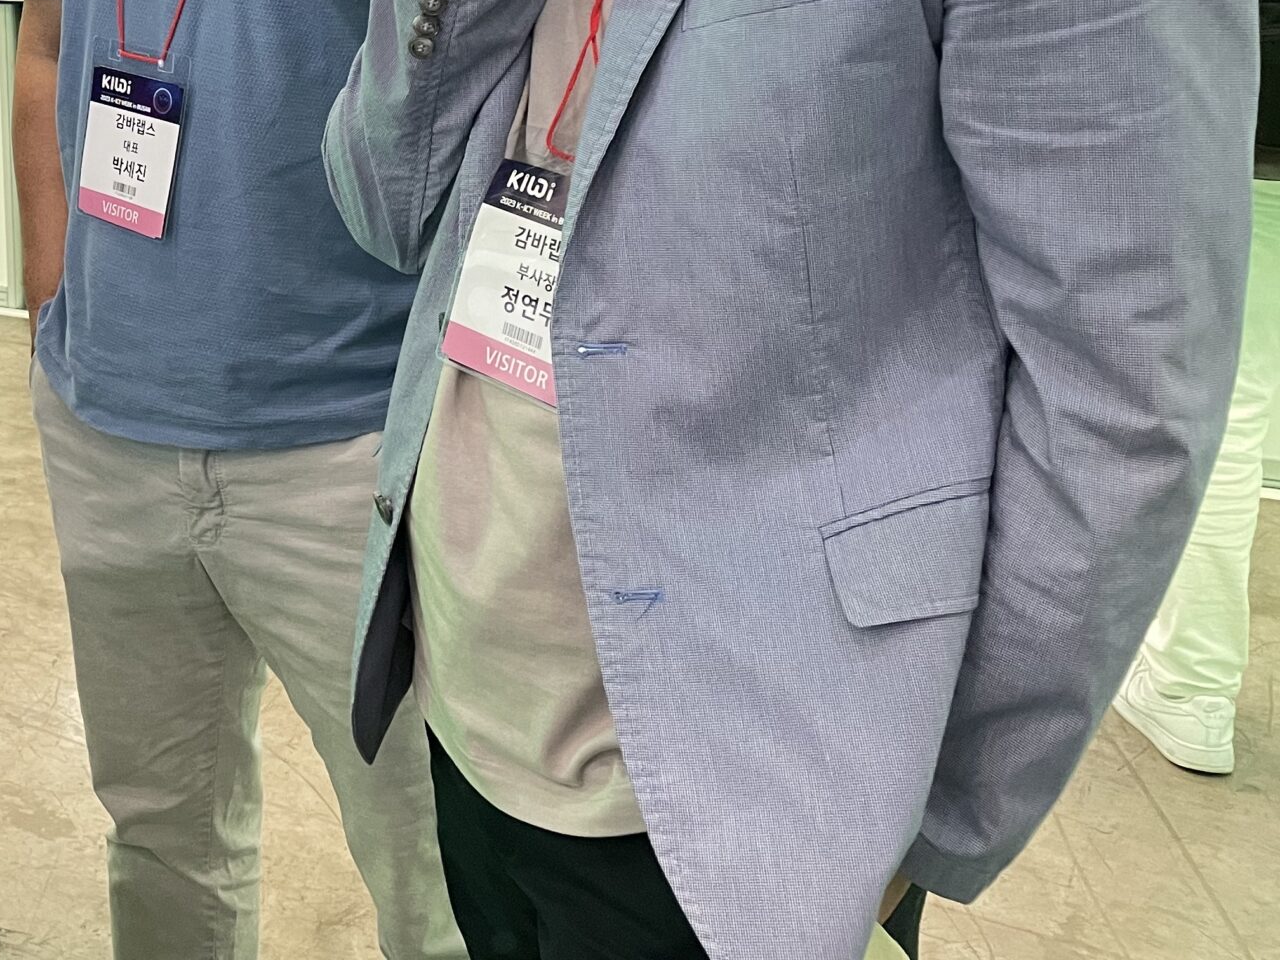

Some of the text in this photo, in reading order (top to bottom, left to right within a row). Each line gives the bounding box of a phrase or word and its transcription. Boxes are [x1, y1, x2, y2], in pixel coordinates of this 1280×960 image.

[115, 113, 156, 137] 감바랩스
[123, 140, 138, 154] 대표
[112, 155, 147, 182] 박세진
[102, 200, 139, 225] VISITOR
[500, 195, 517, 208] 2023
[516, 201, 533, 214] K-ICT
[532, 207, 552, 221] WEEK
[516, 263, 556, 292] 부사장
[485, 346, 548, 389] VISITOR
